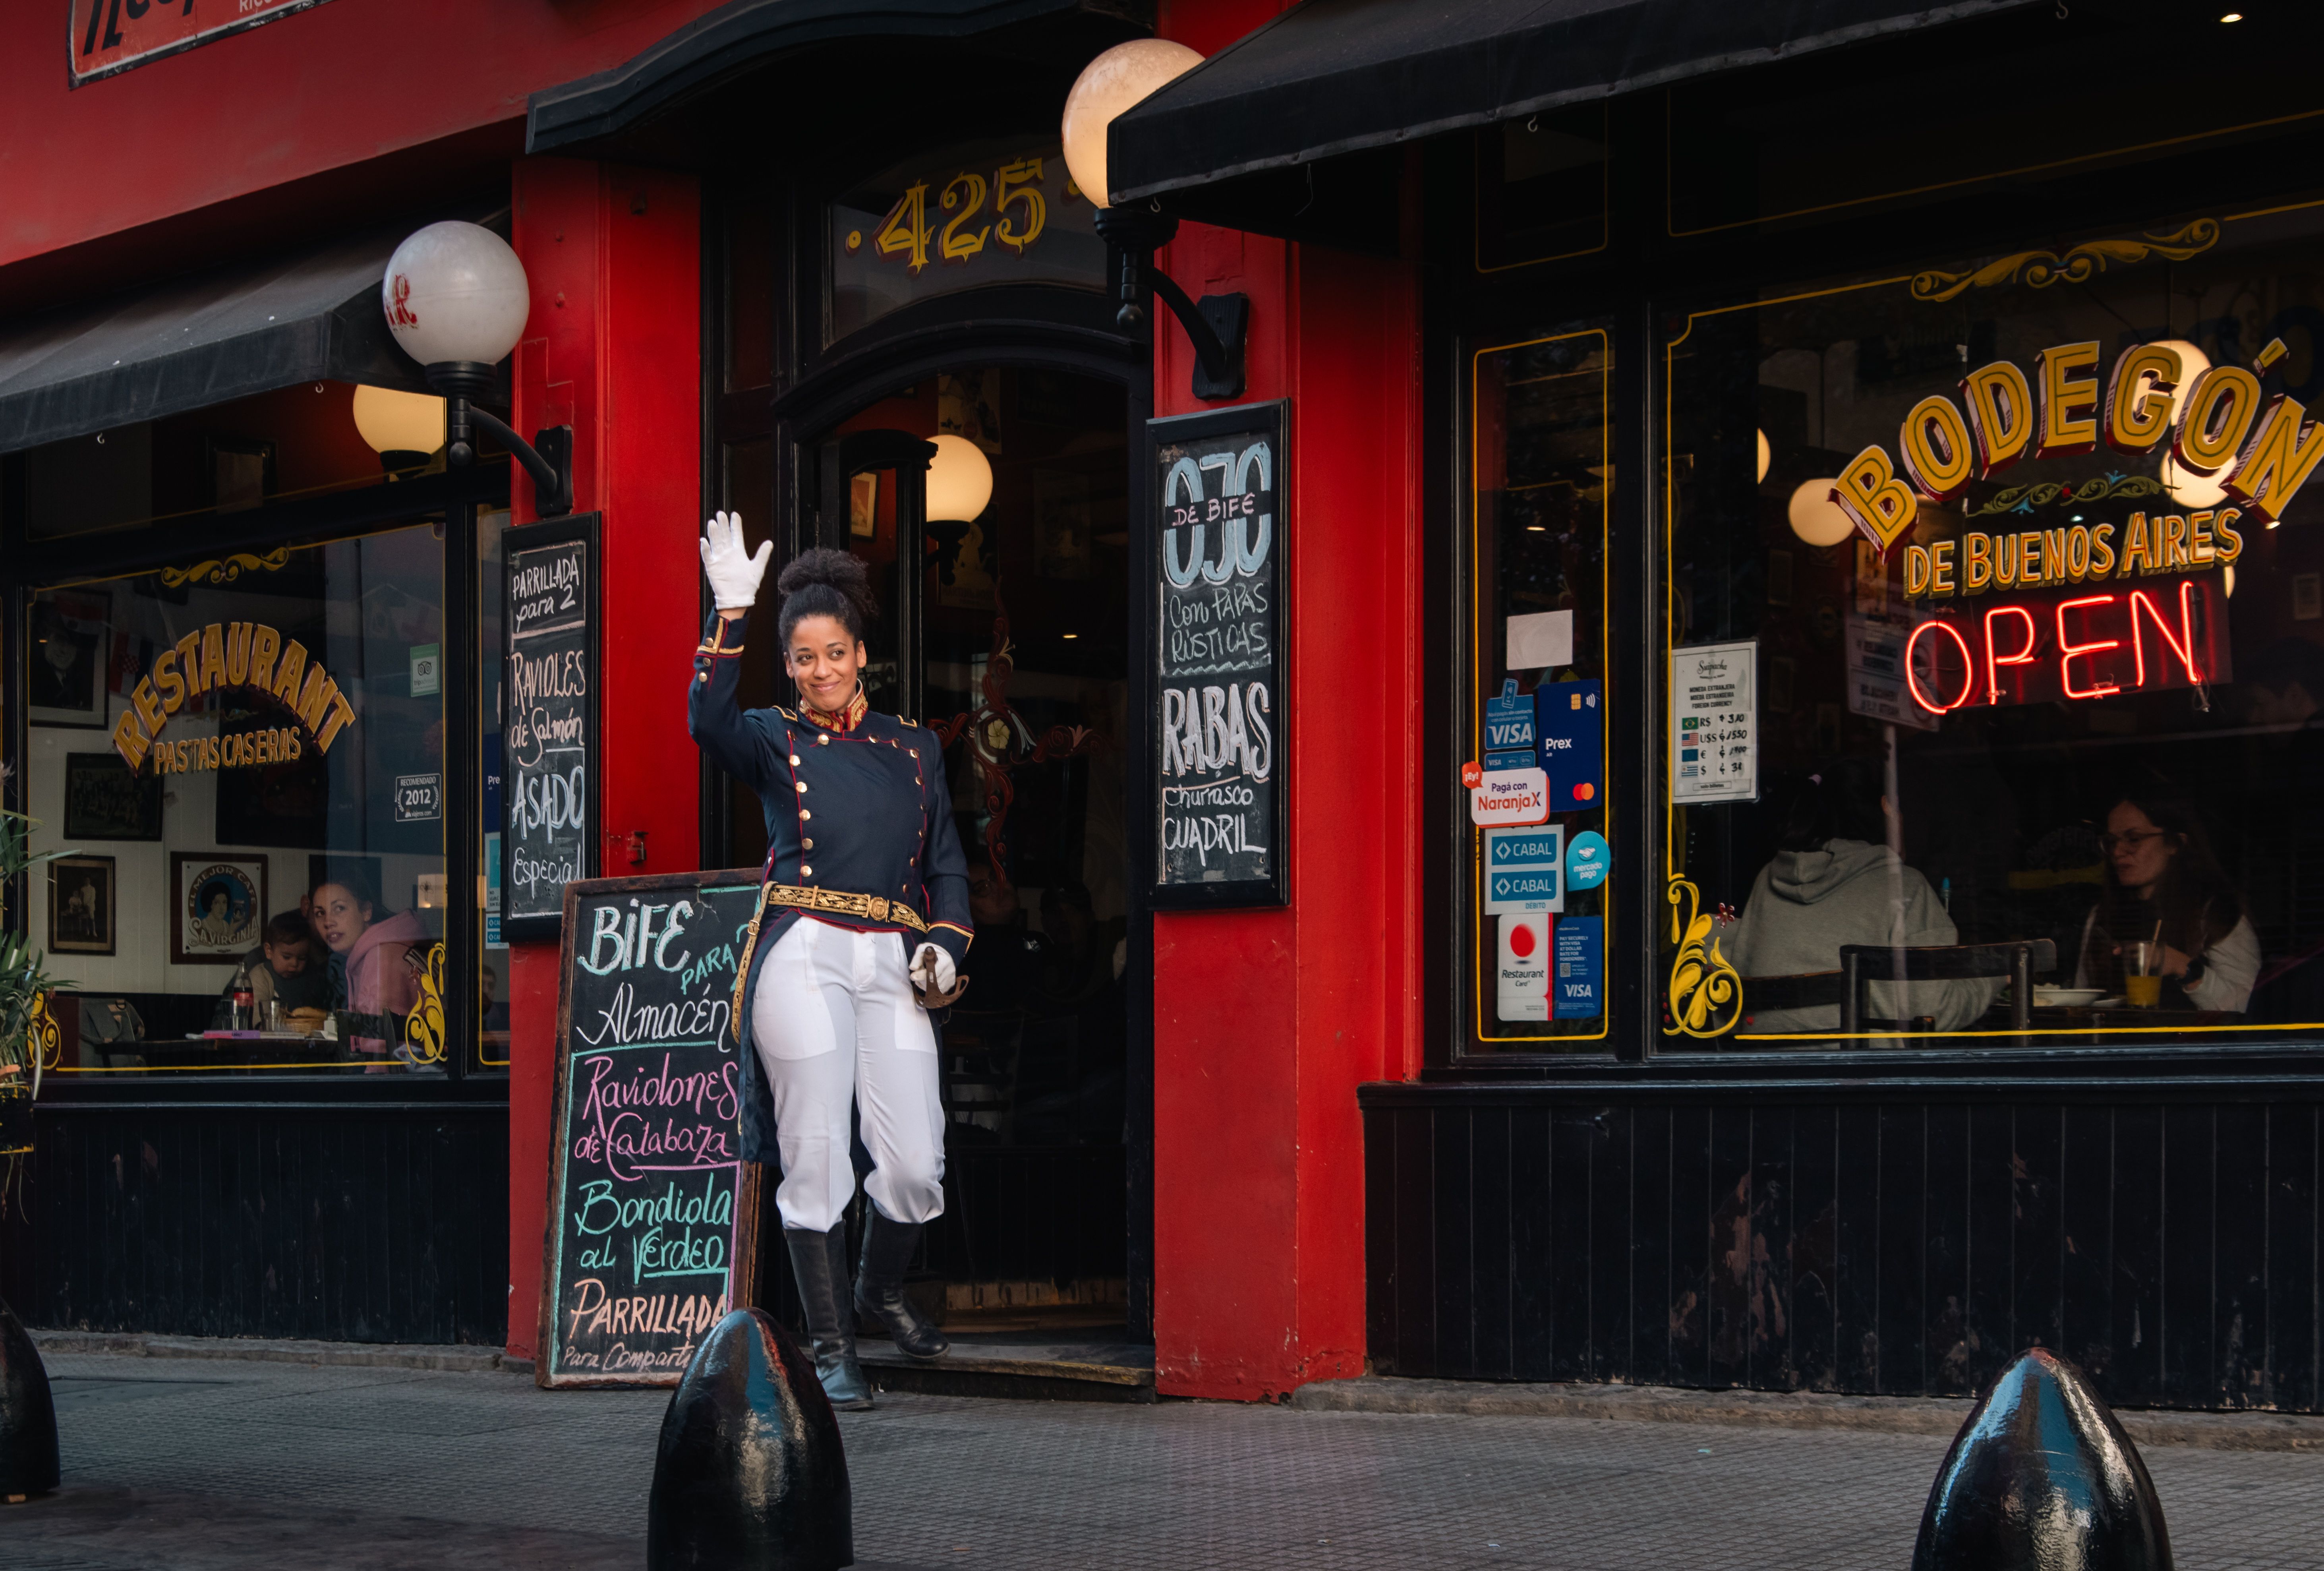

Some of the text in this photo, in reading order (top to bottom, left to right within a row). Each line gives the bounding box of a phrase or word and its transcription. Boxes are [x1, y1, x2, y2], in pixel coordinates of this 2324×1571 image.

[874, 157, 1046, 275] 425
[1827, 337, 2324, 565] BODEGÓN
[1172, 492, 1255, 526] DE BIFE
[513, 554, 579, 600] PARRILLADA
[1904, 508, 2243, 601] DE BUENOS AIRES
[516, 584, 576, 633] para 2
[1212, 582, 1268, 621] PAPAS
[1906, 581, 2204, 715] OPEN
[113, 621, 356, 776] RESTAURANT
[511, 650, 586, 715] RAVIOLES
[154, 726, 302, 775] PASTAS CASERAS
[518, 707, 585, 767] Salmón
[1162, 681, 1271, 783] RABAS
[1488, 723, 1533, 745] VISA
[1545, 738, 1572, 750] Prex
[400, 776, 436, 786] RECOMENDADO
[406, 789, 431, 805] 2012
[488, 776, 500, 785] Pre
[512, 766, 585, 844] ASADO
[1164, 784, 1253, 809] Churrasco
[1492, 782, 1511, 793] Pagá
[1164, 813, 1266, 867] CUADRIL
[1513, 843, 1552, 856] CABAL
[513, 842, 581, 900] Especial
[1513, 878, 1552, 892] CABAL
[1574, 861, 1602, 873] mercado
[1580, 870, 1597, 880] pago
[681, 943, 737, 995] PARA
[1502, 969, 1544, 978] Restaurant
[1564, 984, 1592, 998] VISA
[576, 982, 731, 1052] Almacén
[583, 1052, 738, 1140] Raviolones
[607, 1112, 734, 1181] Calabaza
[574, 1172, 731, 1236] Bondiola
[569, 1278, 727, 1339] PARRILLADA
[563, 1341, 695, 1372] Para Comparti
